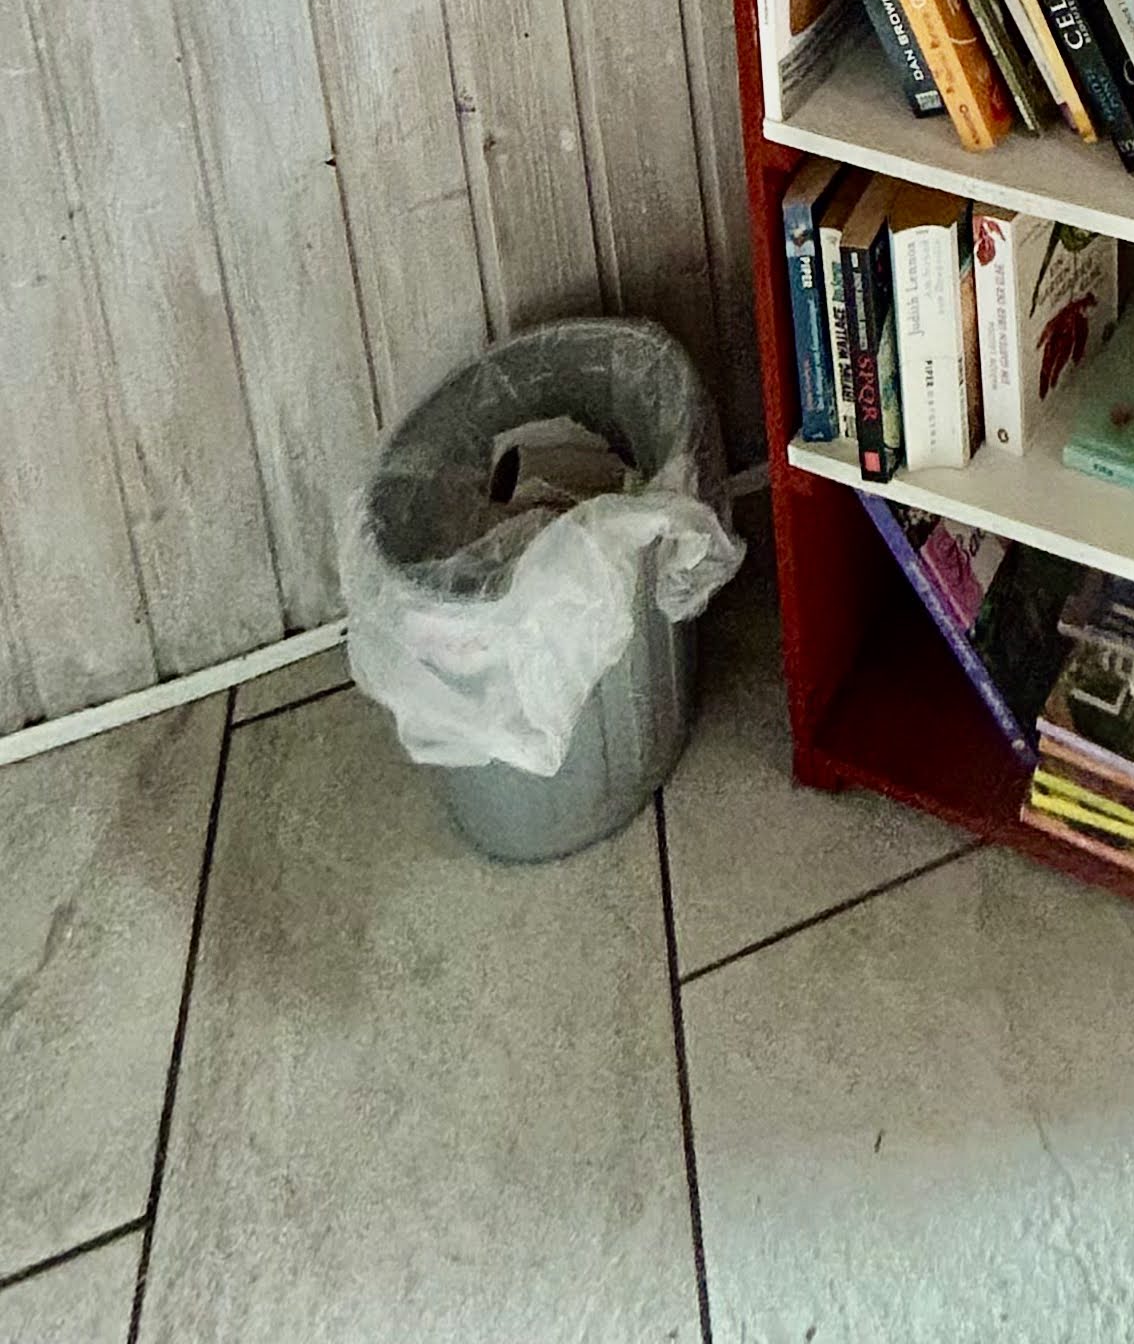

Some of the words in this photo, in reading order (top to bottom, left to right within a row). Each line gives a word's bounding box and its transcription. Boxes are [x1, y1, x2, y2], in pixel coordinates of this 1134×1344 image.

[901, 48, 923, 82] DAN
[800, 255, 814, 288] PIPER
[901, 241, 917, 291] Lennox
[903, 295, 922, 336] Judith
[857, 354, 881, 421] SPQR
